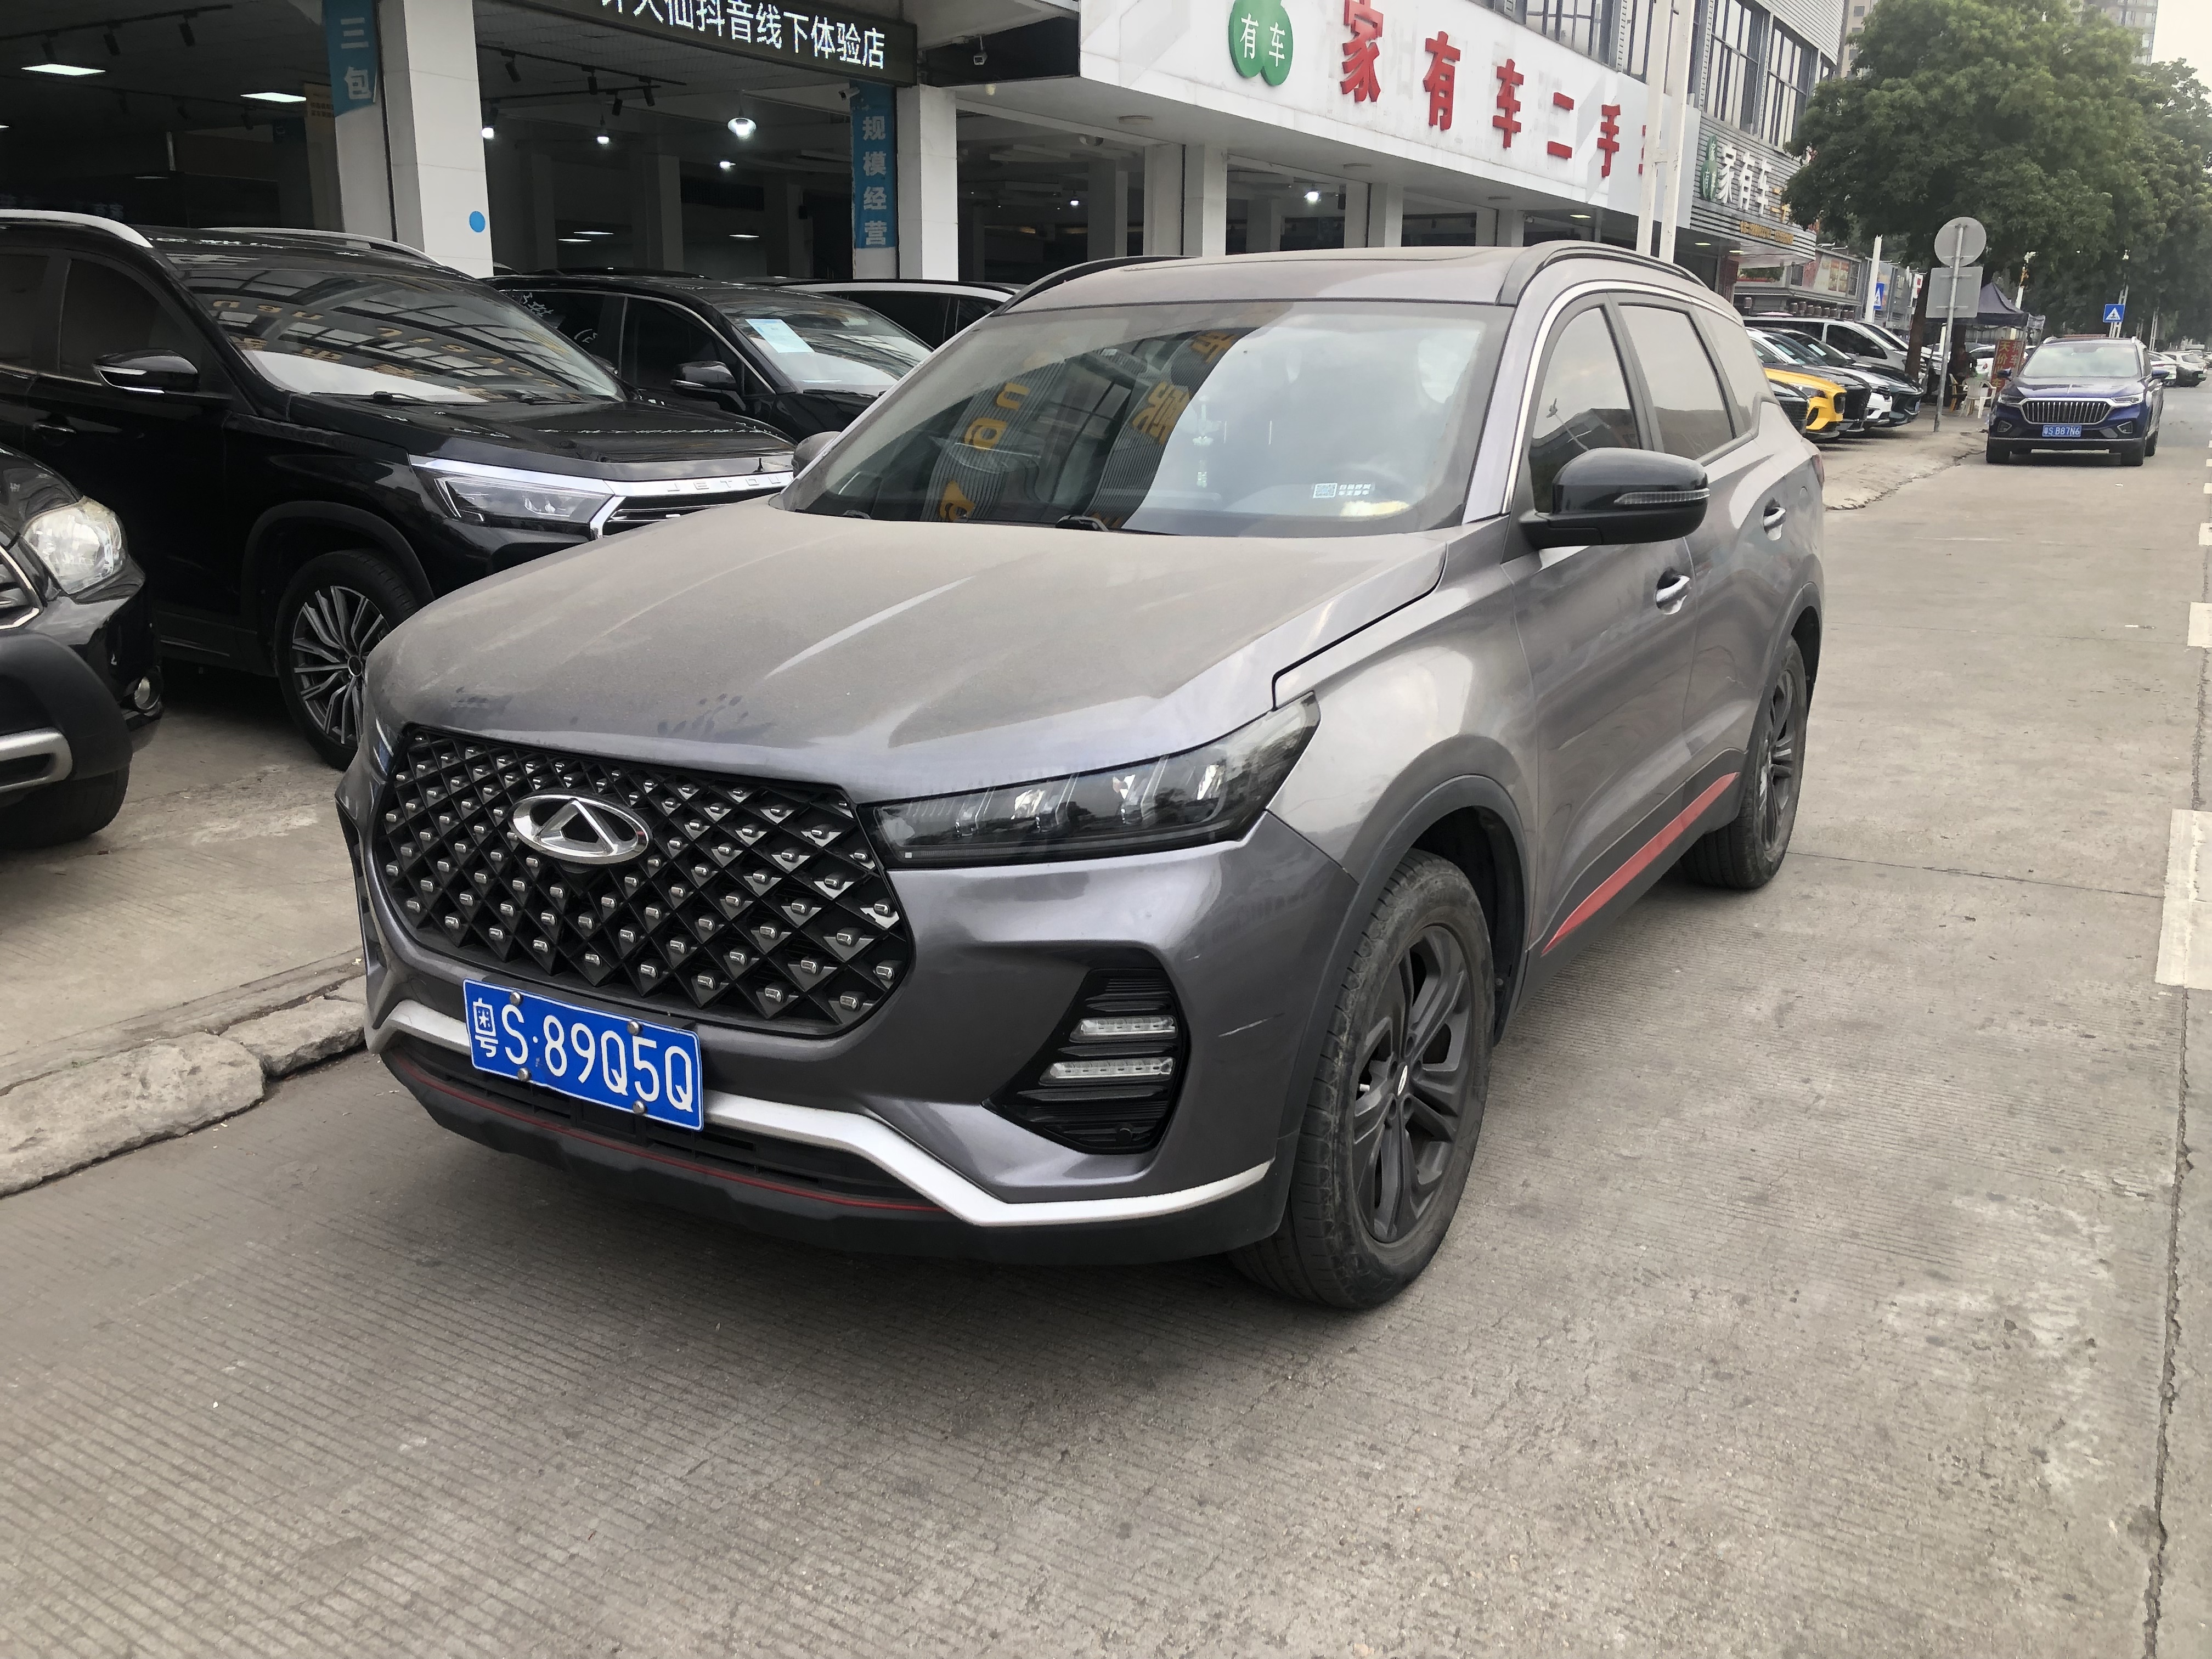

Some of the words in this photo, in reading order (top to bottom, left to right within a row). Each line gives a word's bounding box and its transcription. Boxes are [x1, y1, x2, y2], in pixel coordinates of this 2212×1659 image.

[1239, 13, 1285, 67] 有车
[1340, 0, 1646, 178] 家有车二手
[862, 116, 887, 245] 规模经营
[667, 474, 794, 492] JETOU
